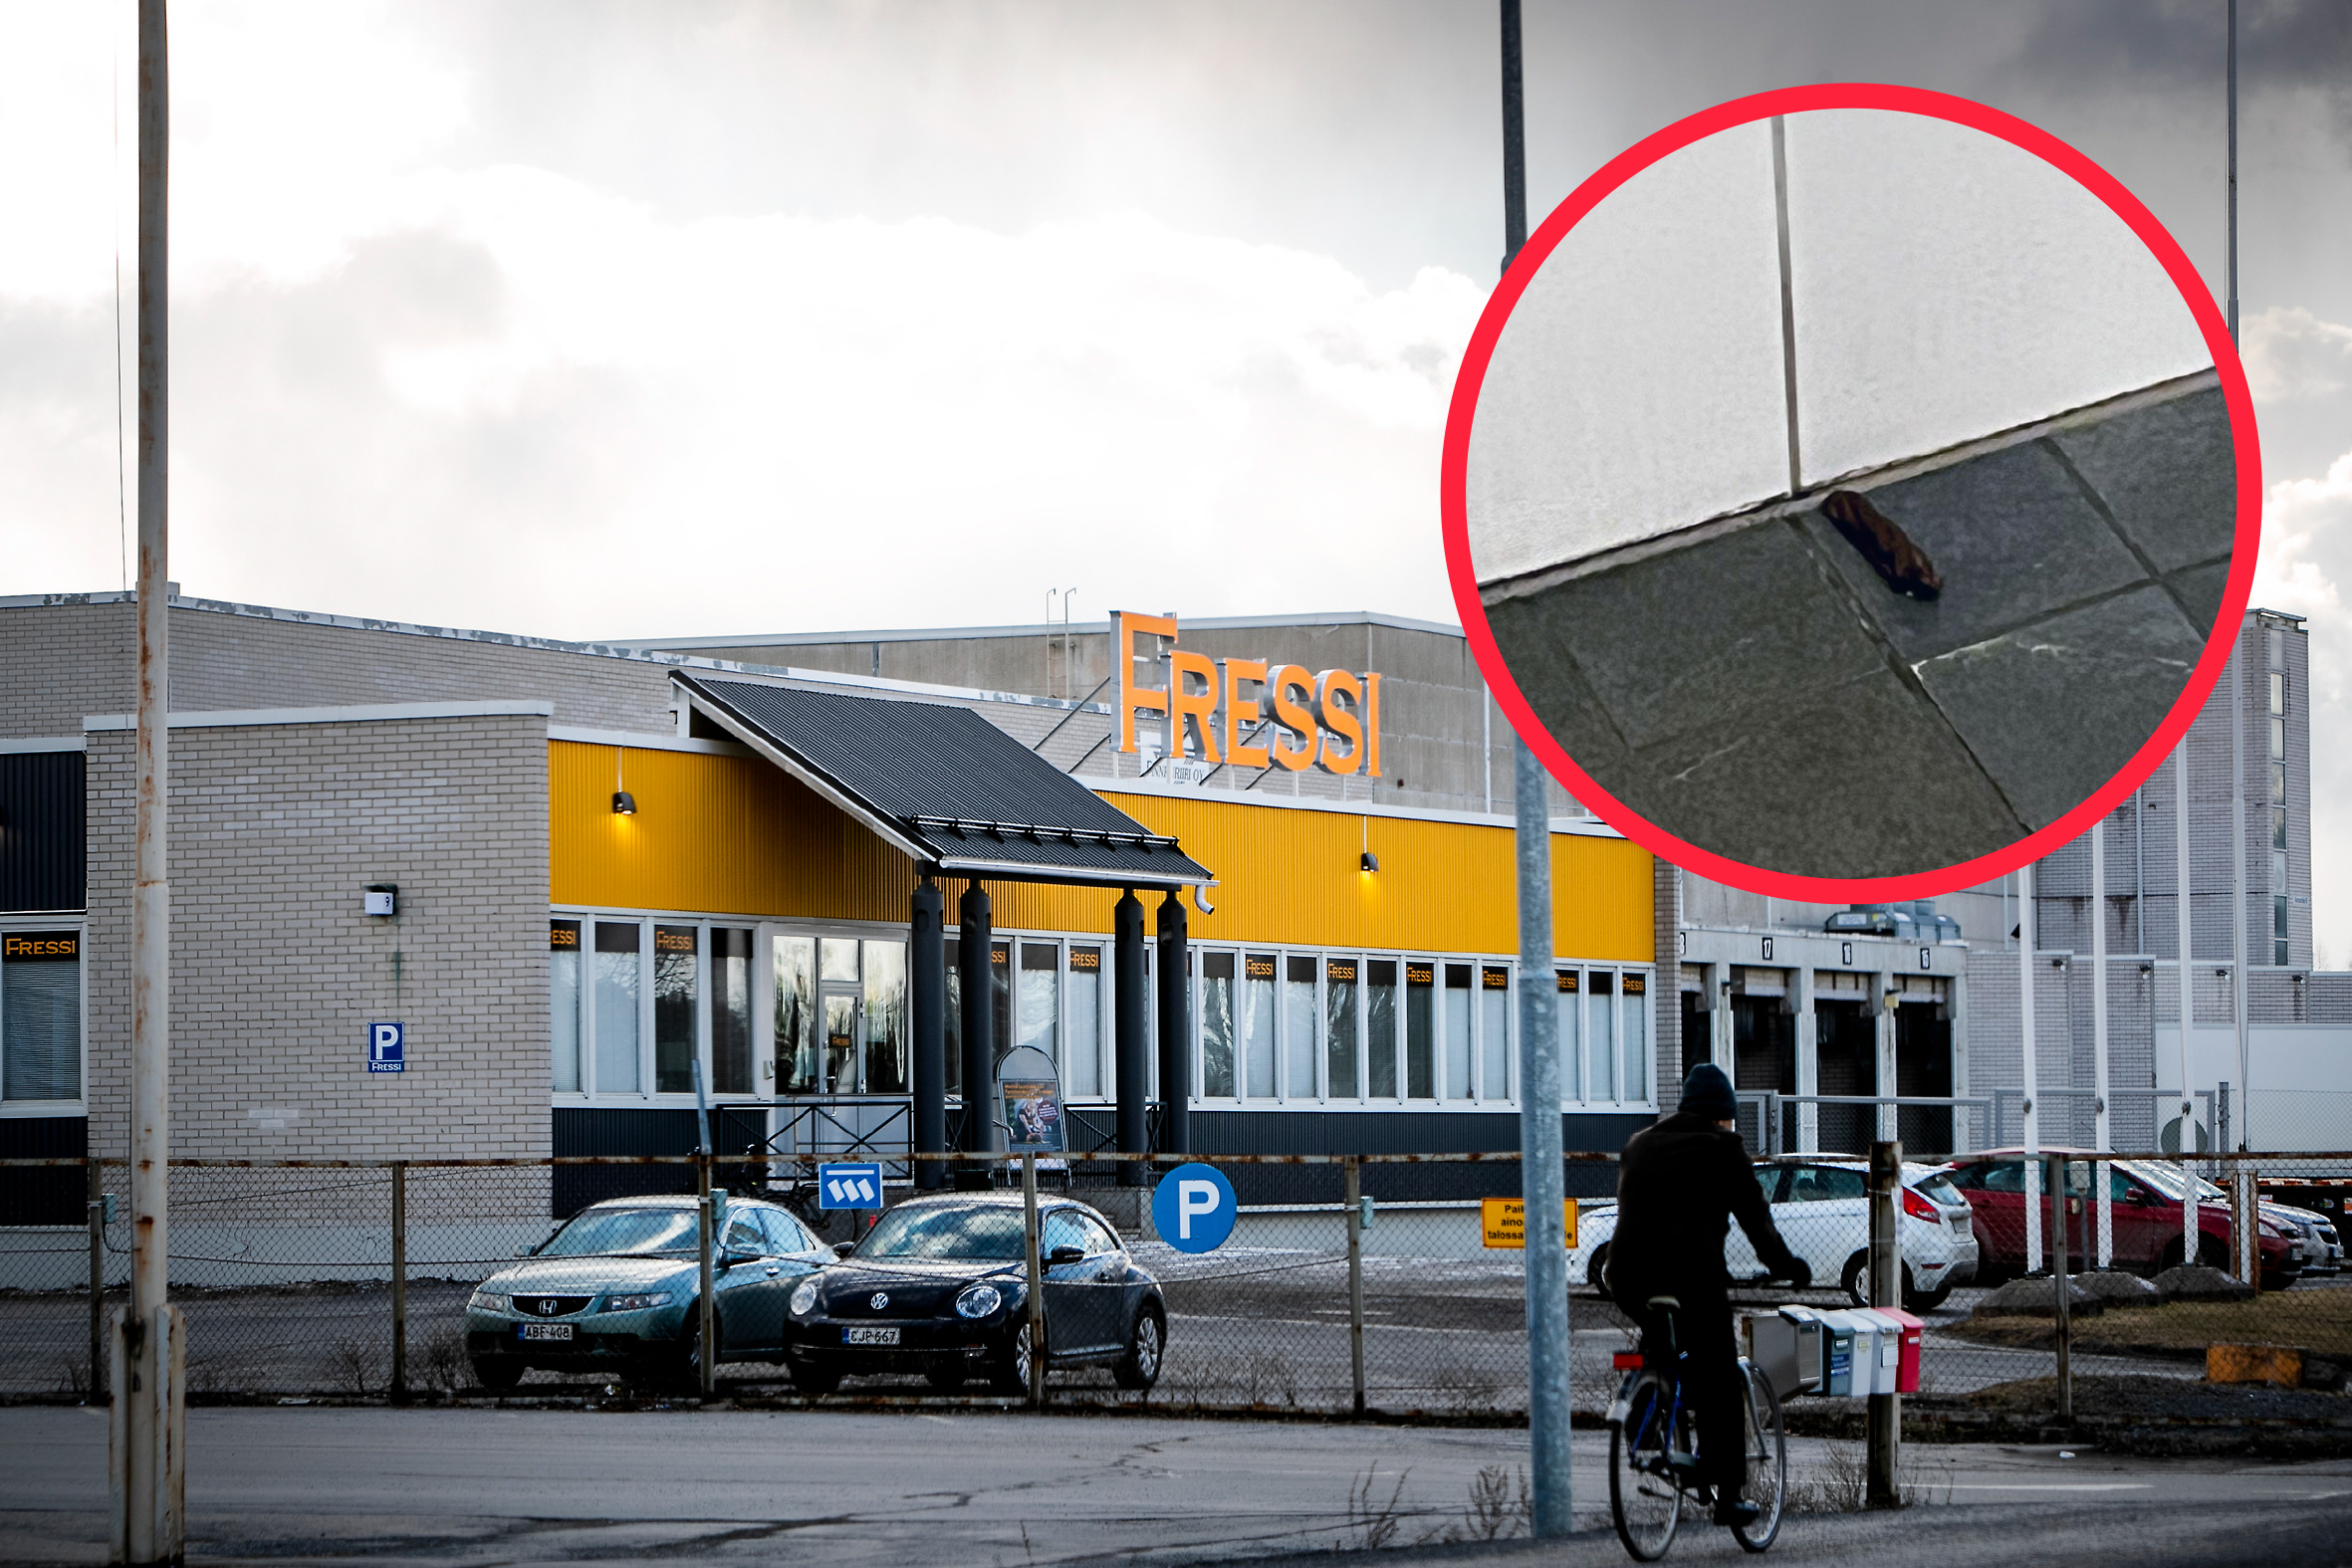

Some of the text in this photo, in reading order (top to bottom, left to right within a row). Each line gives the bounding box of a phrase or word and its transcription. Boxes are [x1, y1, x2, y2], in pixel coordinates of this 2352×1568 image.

[1110, 610, 1382, 778] FRESSI
[551, 929, 577, 945] ESSI
[655, 931, 694, 950] FRESSI
[6, 938, 76, 955] FRESSI
[1069, 950, 1099, 967] FRESSI
[1246, 959, 1274, 976] FRESSI
[1327, 963, 1355, 980] FRESSI
[1407, 967, 1433, 984] FRESSI
[1483, 971, 1506, 987] FRESSI
[1622, 977, 1644, 992] FRESSI
[375, 1024, 399, 1060] P
[371, 1062, 402, 1071] FRESSI
[1179, 1180, 1221, 1239] P
[525, 1326, 571, 1339] ABF-408
